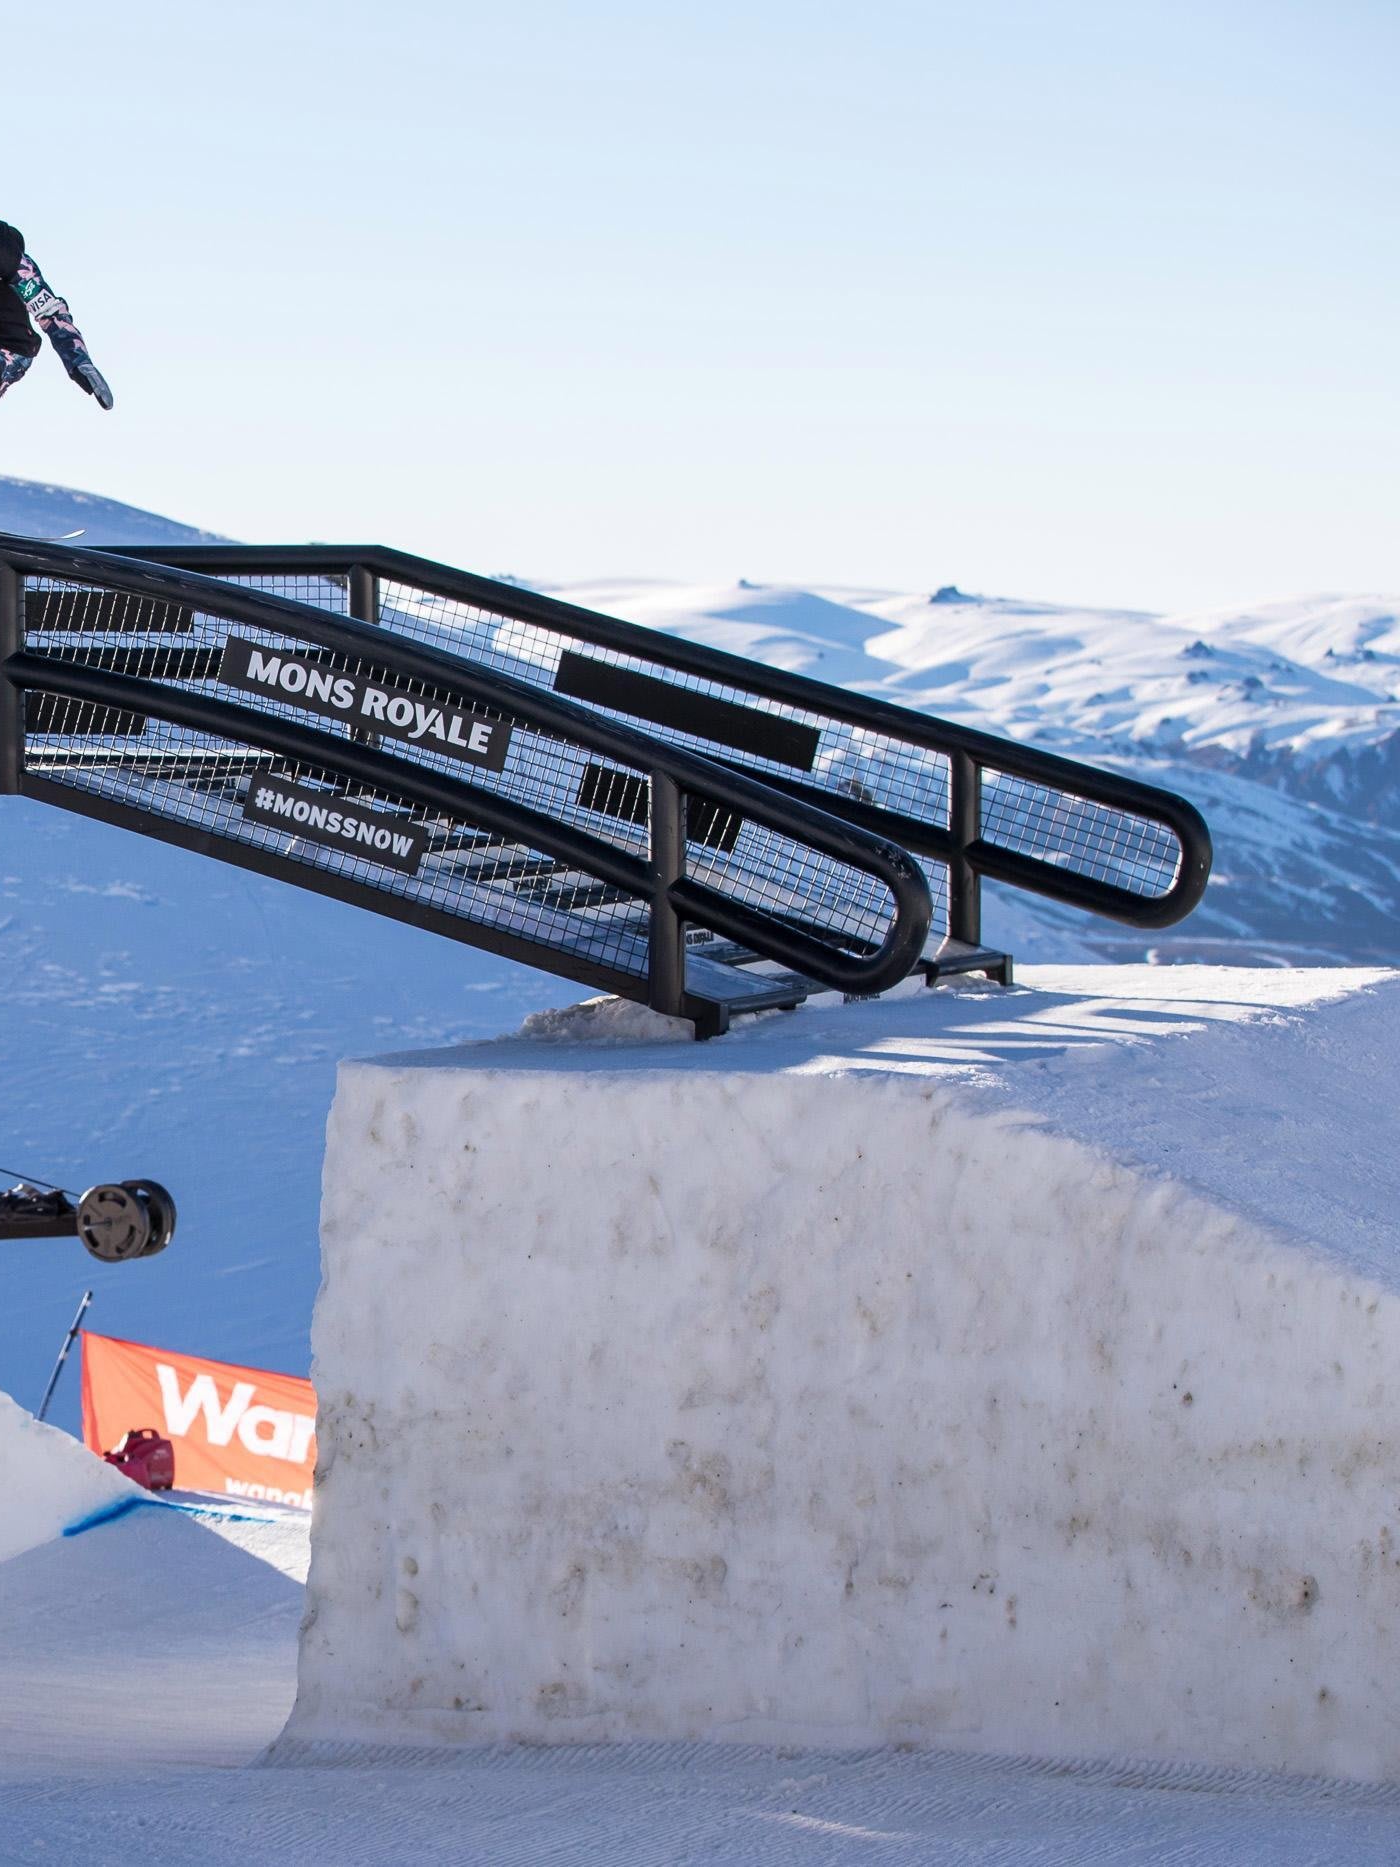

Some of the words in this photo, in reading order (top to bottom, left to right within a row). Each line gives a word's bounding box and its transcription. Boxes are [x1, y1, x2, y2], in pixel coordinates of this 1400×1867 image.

[30, 292, 52, 312] VISA
[246, 650, 356, 709] MONS
[360, 686, 493, 754] ROYALE
[254, 787, 414, 858] #MONSSNOW
